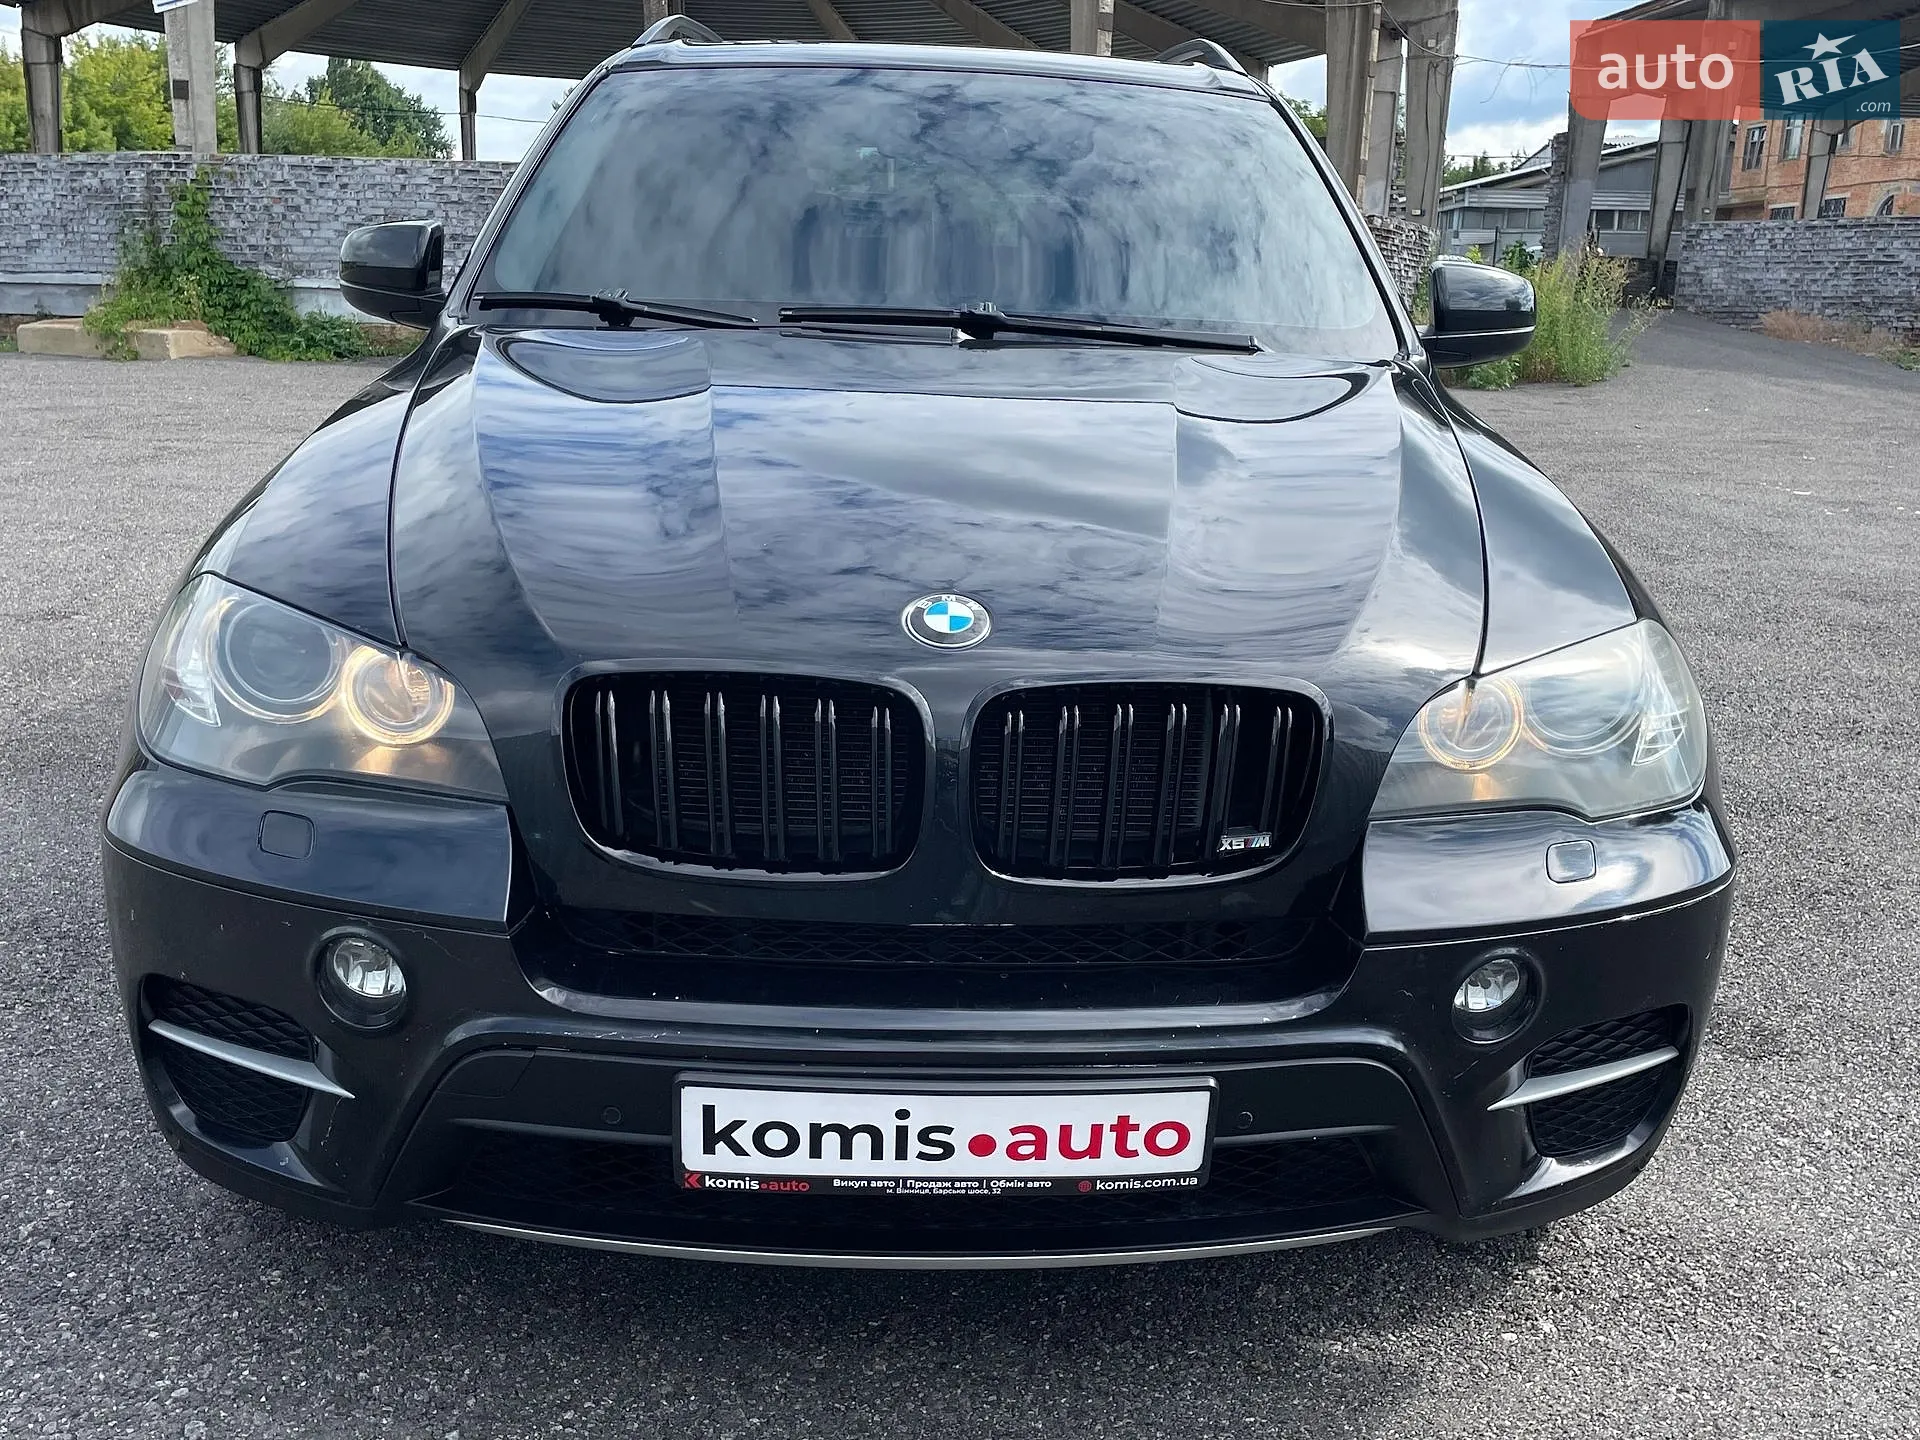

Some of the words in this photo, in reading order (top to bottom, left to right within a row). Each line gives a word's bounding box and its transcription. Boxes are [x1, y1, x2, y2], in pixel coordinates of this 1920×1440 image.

[833, 1178, 868, 1189] Викуп
[870, 1180, 896, 1188] авто
[906, 1179, 952, 1189] Продаж
[953, 1180, 980, 1188] авто
[990, 1179, 1025, 1188] Обмін
[1026, 1180, 1052, 1188] авто
[1096, 1176, 1198, 1191] komis.com.ua
